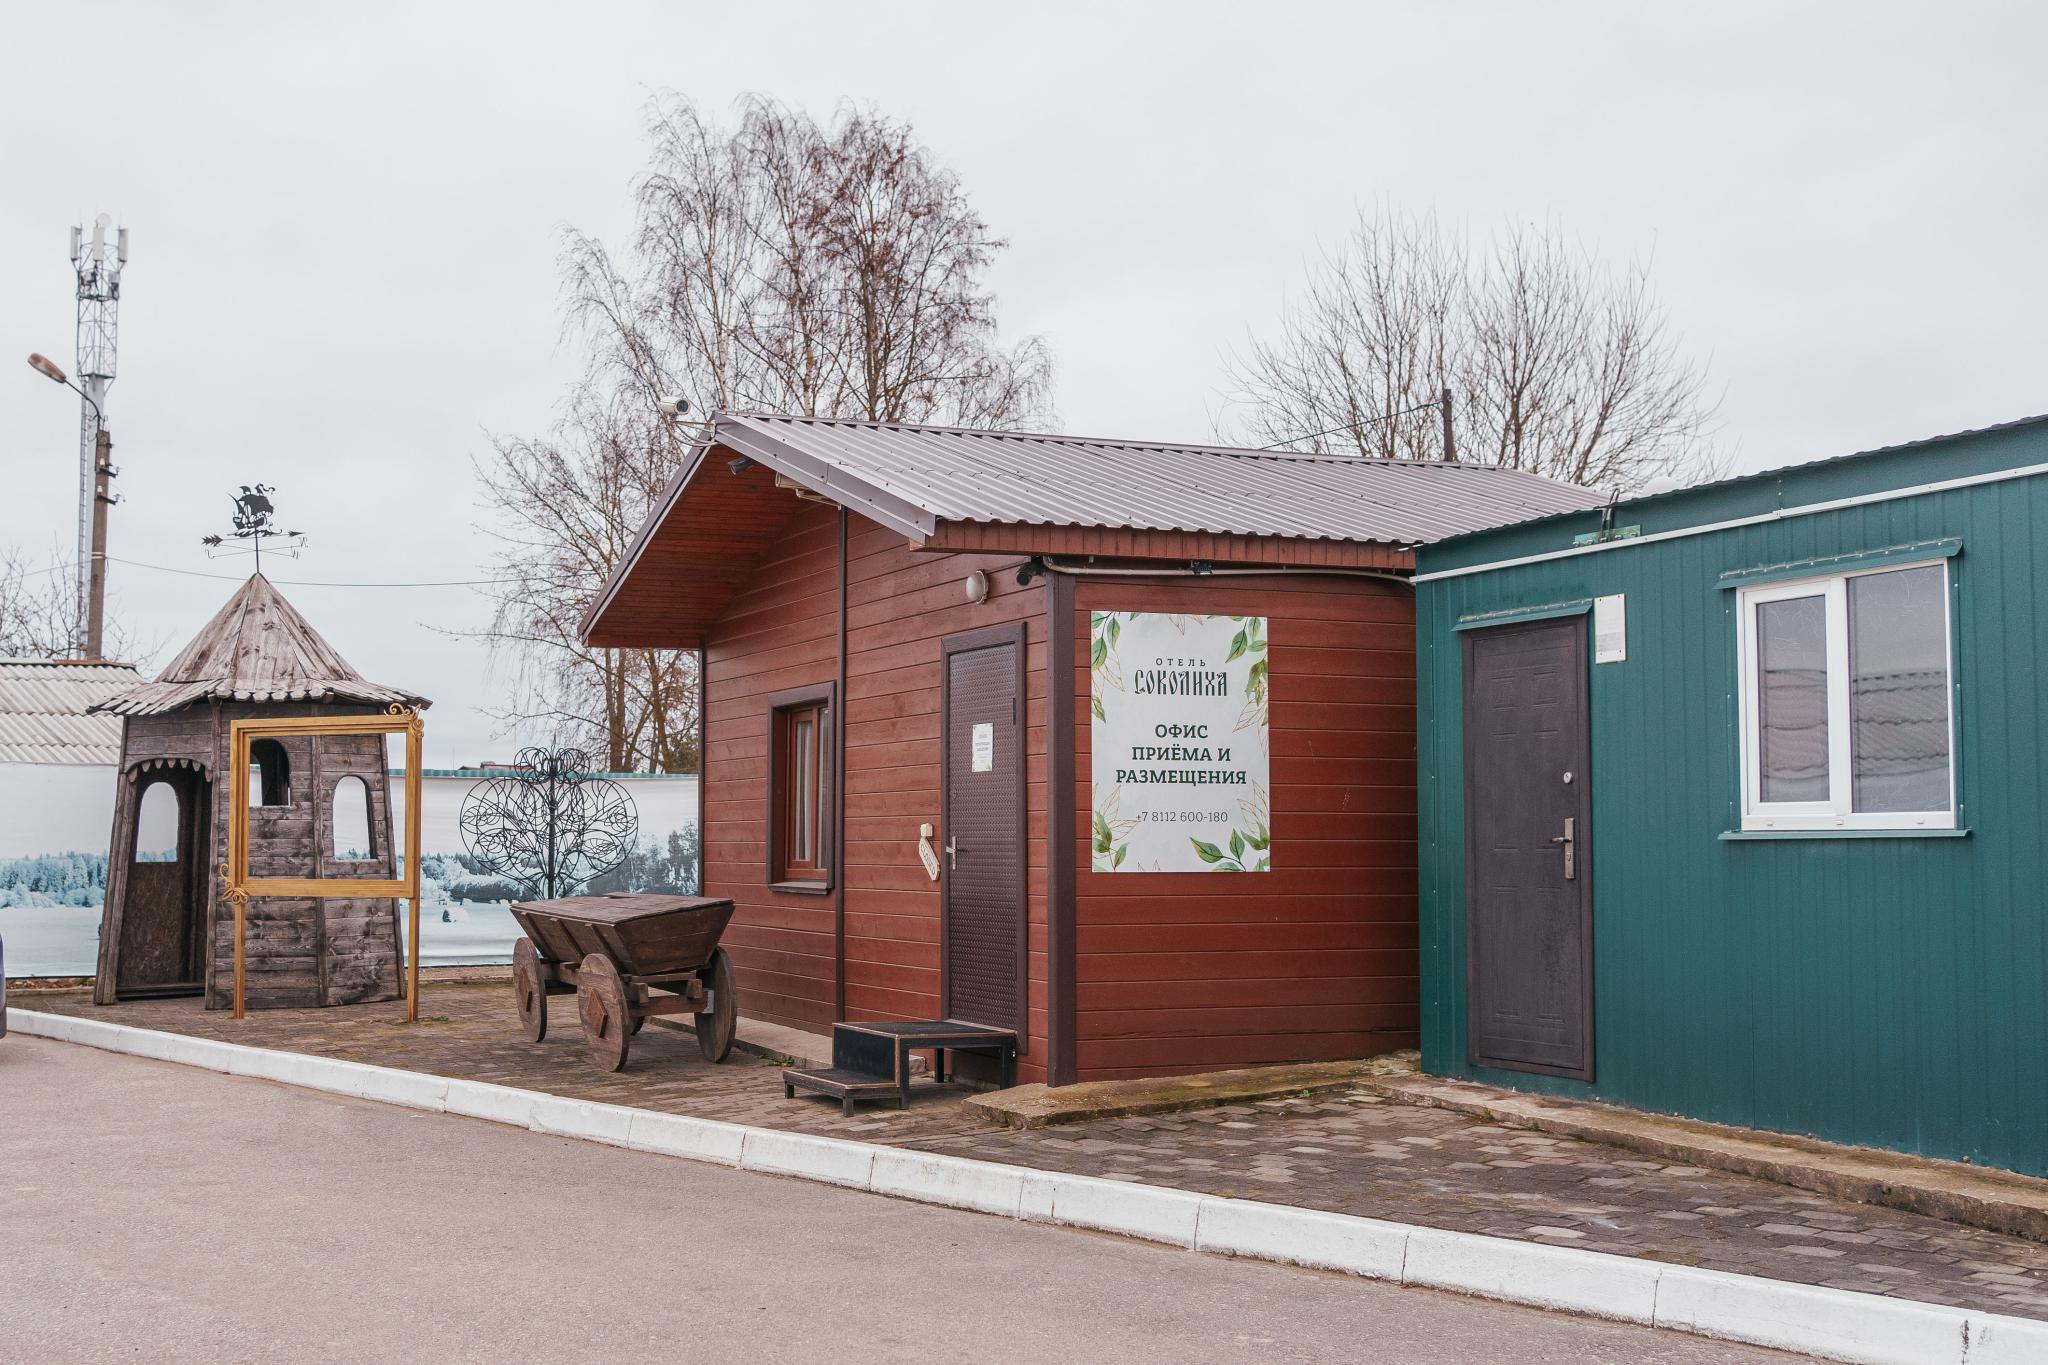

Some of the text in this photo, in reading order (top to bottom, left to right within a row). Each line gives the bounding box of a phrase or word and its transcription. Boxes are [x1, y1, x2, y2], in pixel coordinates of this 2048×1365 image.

[1156, 658, 1207, 668] ОТЕЛЬ
[1135, 670, 1227, 696] СОКОЛИХА
[1155, 724, 1208, 739] ОФИС
[1132, 744, 1231, 761] ПРИЁМА И
[1116, 770, 1247, 786] РАЗМЕЩЕНИЯ
[1135, 812, 1228, 822] +7 8112 600-180
